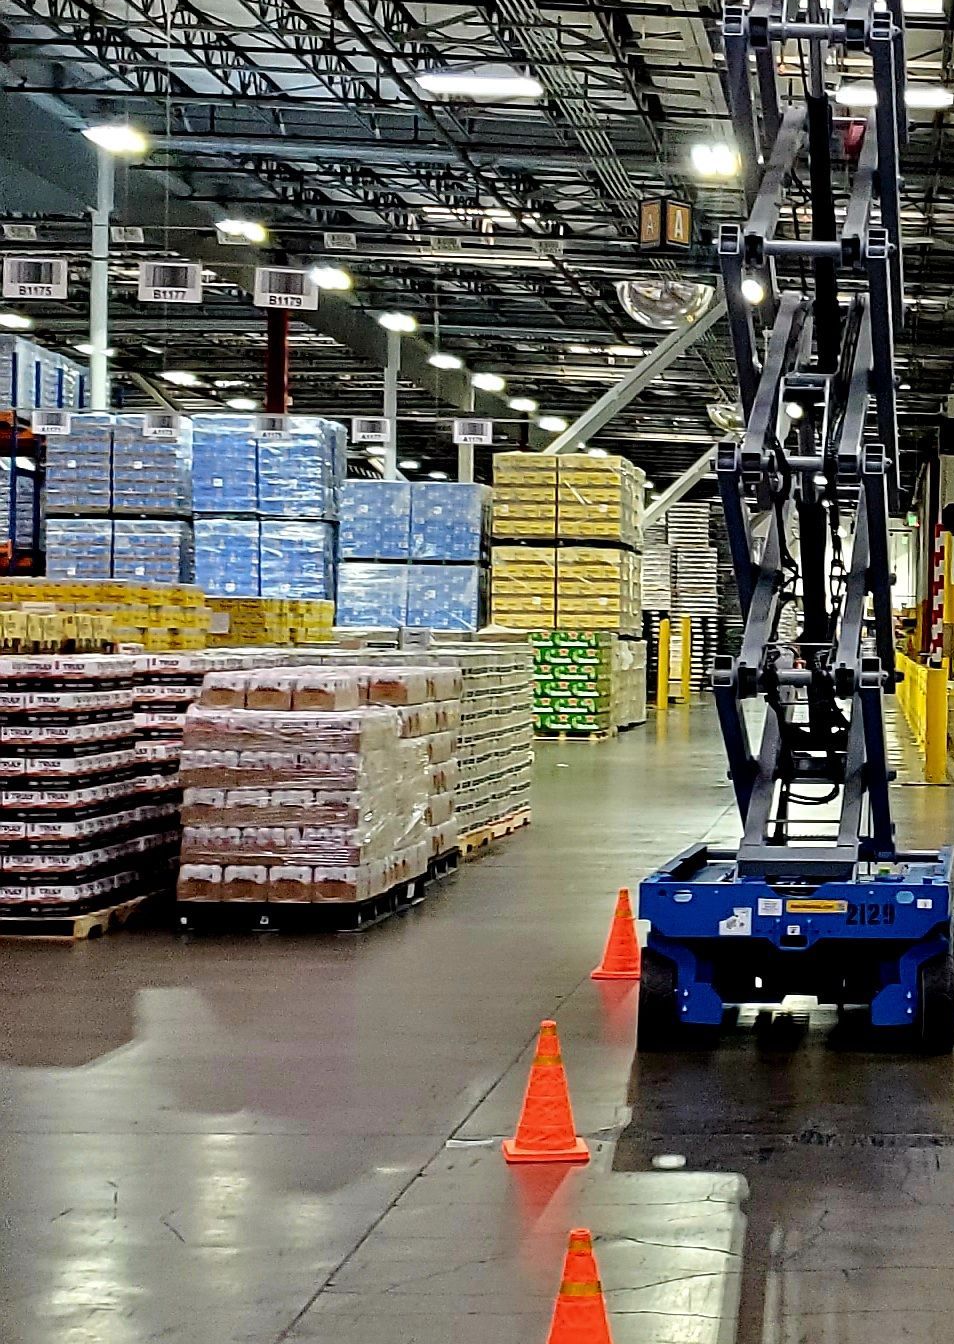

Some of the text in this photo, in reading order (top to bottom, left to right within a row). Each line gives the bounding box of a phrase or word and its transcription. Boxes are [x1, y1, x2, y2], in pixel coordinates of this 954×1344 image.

[674, 209, 683, 240] A
[19, 285, 52, 296] B1175
[153, 289, 186, 299] B1177
[269, 295, 302, 306] B1179
[62, 662, 85, 671] TRULY
